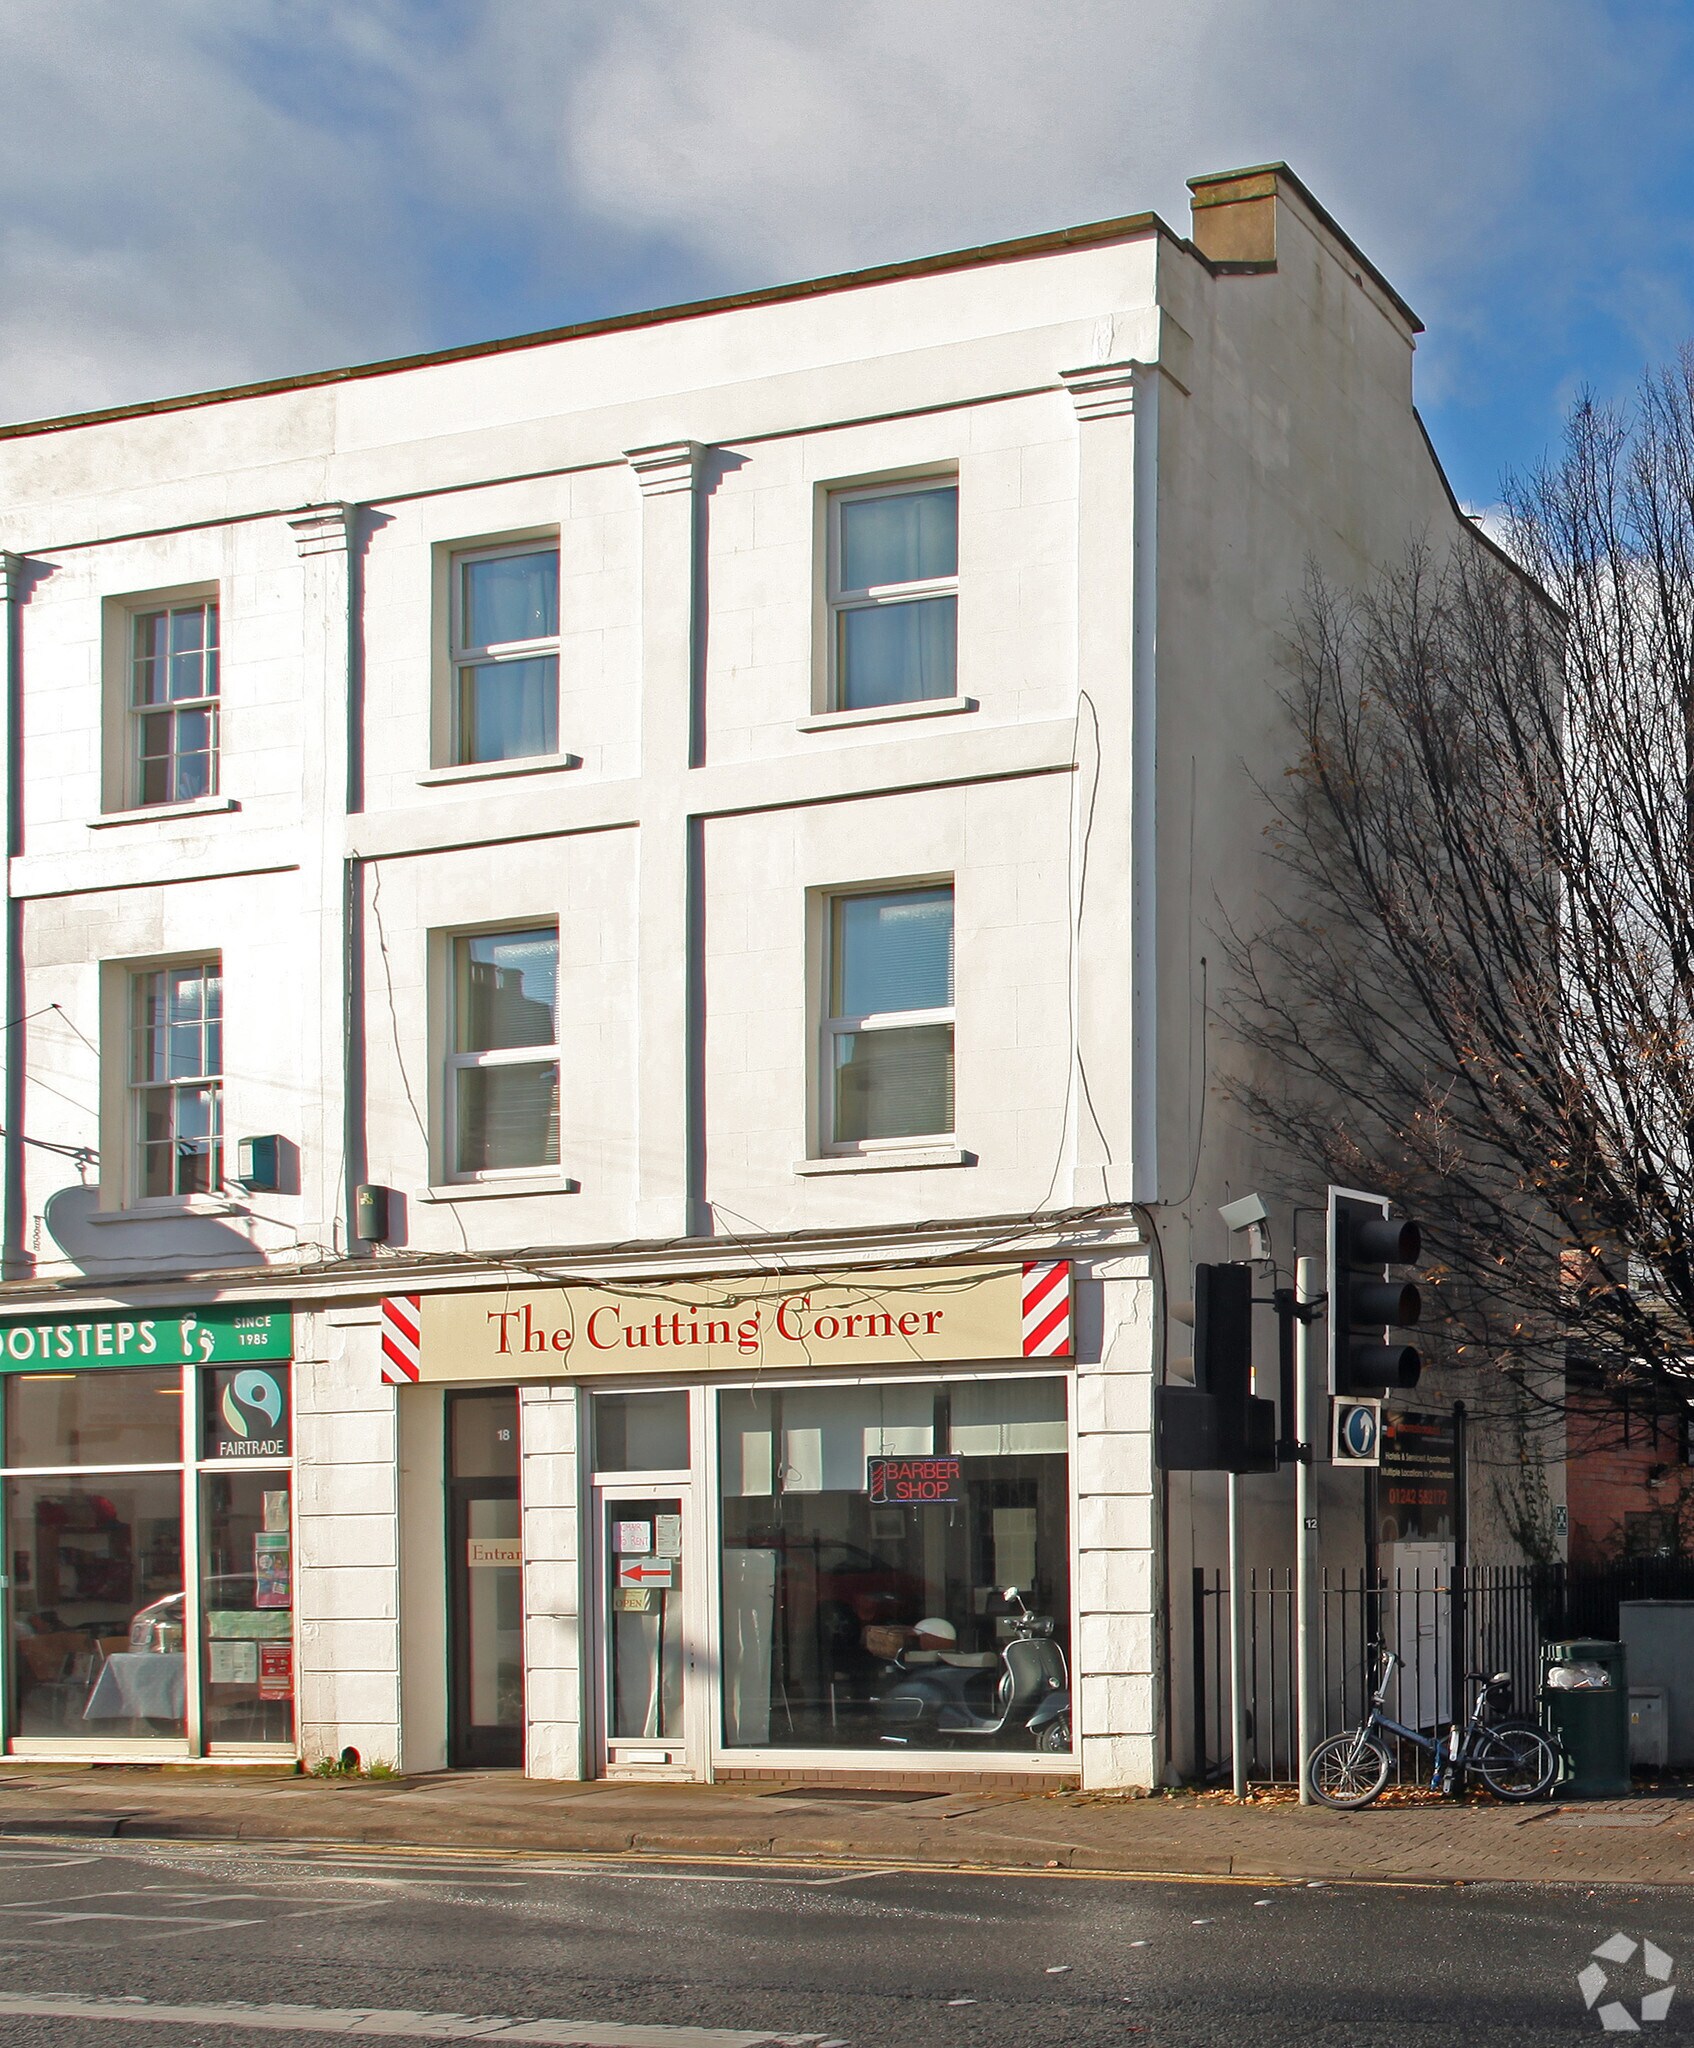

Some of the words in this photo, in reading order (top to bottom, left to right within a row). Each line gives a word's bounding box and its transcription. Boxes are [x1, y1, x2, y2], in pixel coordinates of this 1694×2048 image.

[234, 1316, 272, 1329] SINCE
[486, 1304, 572, 1354] The
[587, 1303, 760, 1355] Cutting
[776, 1293, 944, 1341] Corner
[0, 1320, 158, 1360] OTSTEPS
[239, 1333, 268, 1346] 1985
[497, 1429, 511, 1441] 18
[219, 1440, 284, 1456] FAIRTRADE
[887, 1462, 960, 1480] BARBER
[895, 1481, 949, 1499] SHOP
[1388, 1488, 1417, 1505] 01242
[1305, 1518, 1318, 1529] 12
[630, 1535, 648, 1546] RENT
[615, 1599, 642, 1608] OPEN
